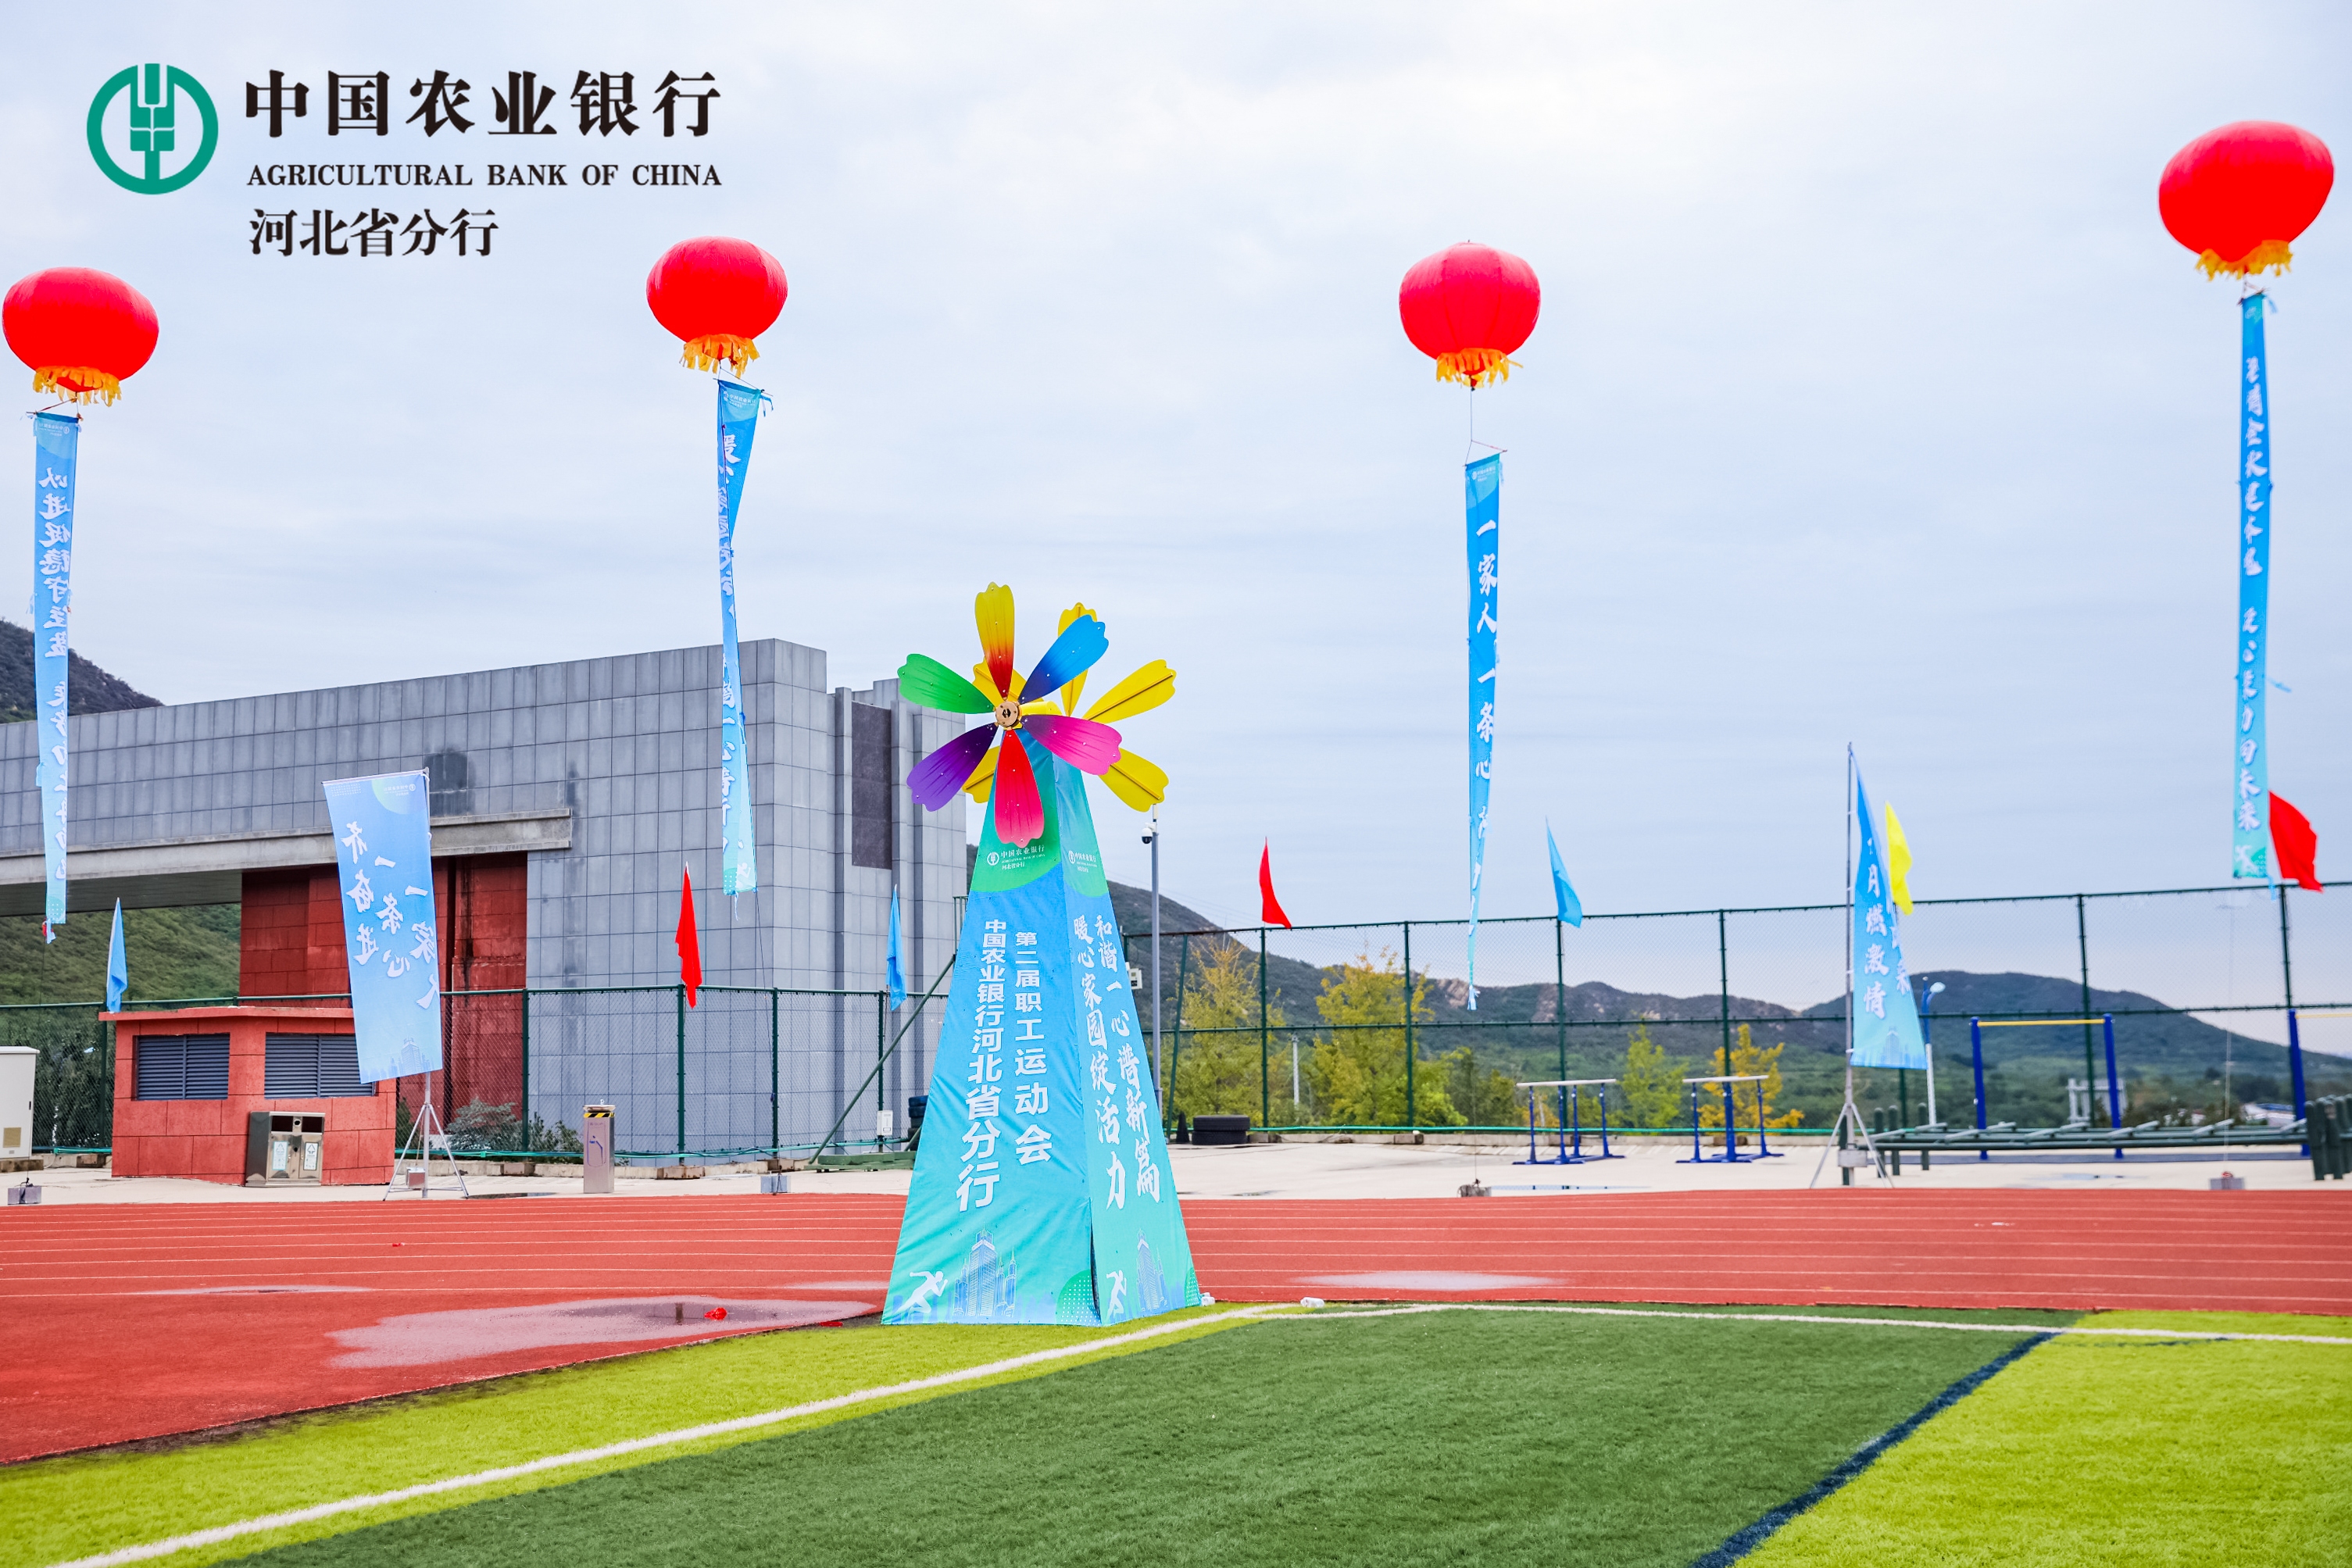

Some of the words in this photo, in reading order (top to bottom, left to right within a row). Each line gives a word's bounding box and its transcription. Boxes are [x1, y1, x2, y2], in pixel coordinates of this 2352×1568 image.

[956, 919, 1007, 1213] 中国农业银行河北省分行
[1014, 931, 1052, 1166] 第二届职工运动会
[1073, 915, 1126, 1211] 暖心家园绽活力
[1096, 915, 1160, 1204] 和谐一心谱新篇
[1864, 838, 1889, 1020] 月燃激情
